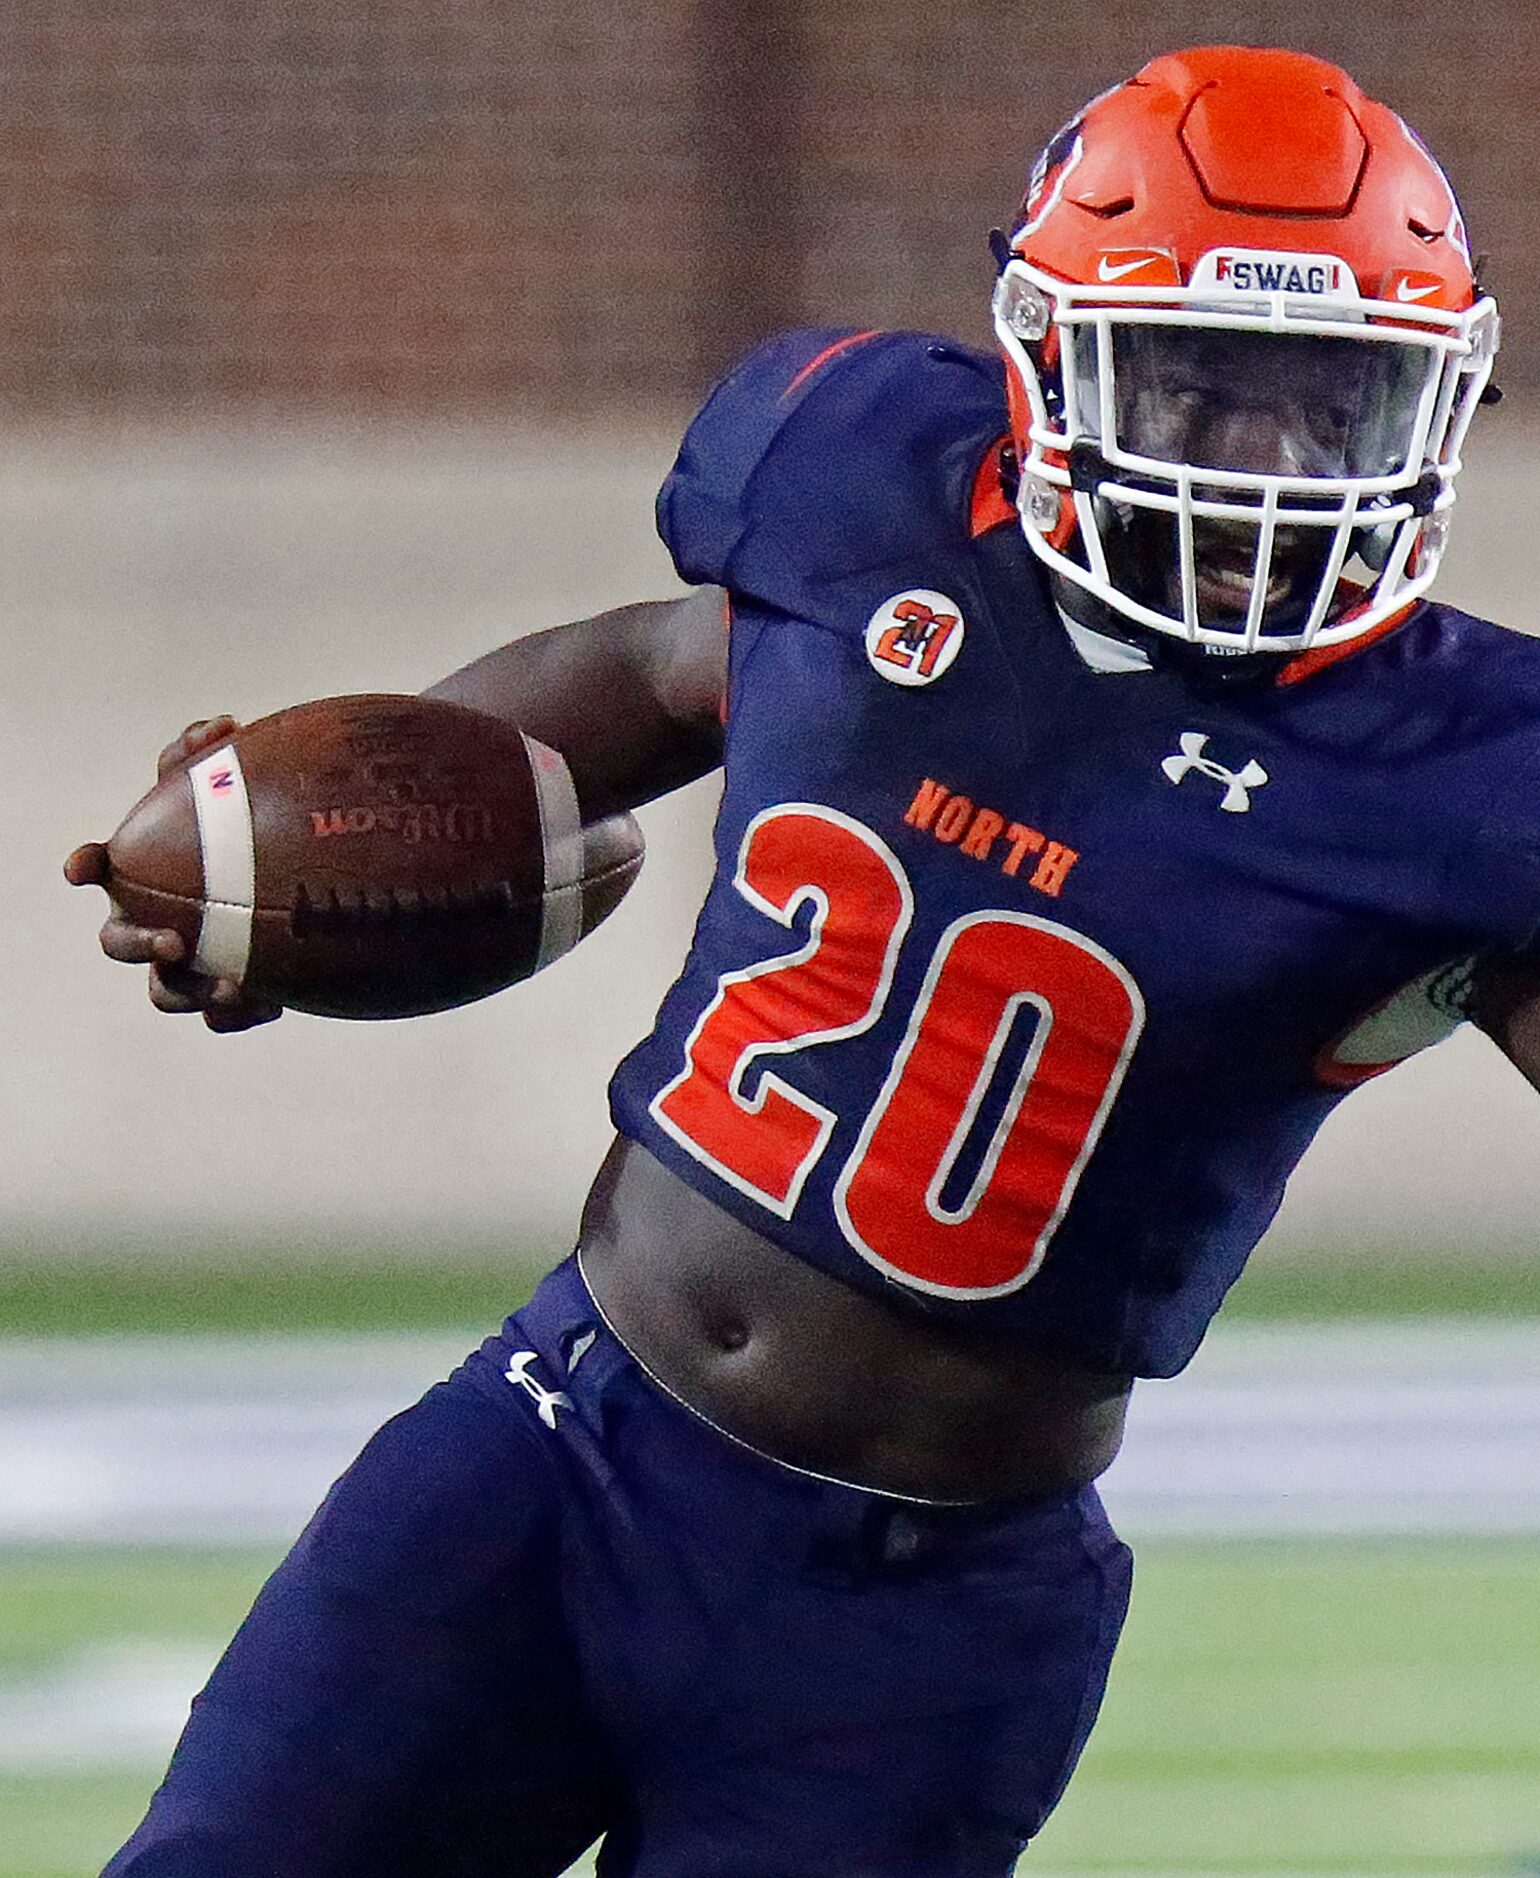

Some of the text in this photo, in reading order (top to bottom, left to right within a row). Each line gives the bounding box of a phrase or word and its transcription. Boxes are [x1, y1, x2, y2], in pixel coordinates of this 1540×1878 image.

[1233, 262, 1325, 294] SWAG
[873, 599, 960, 678] 21
[904, 777, 1080, 898] NORTH
[648, 802, 1146, 1300] 20
